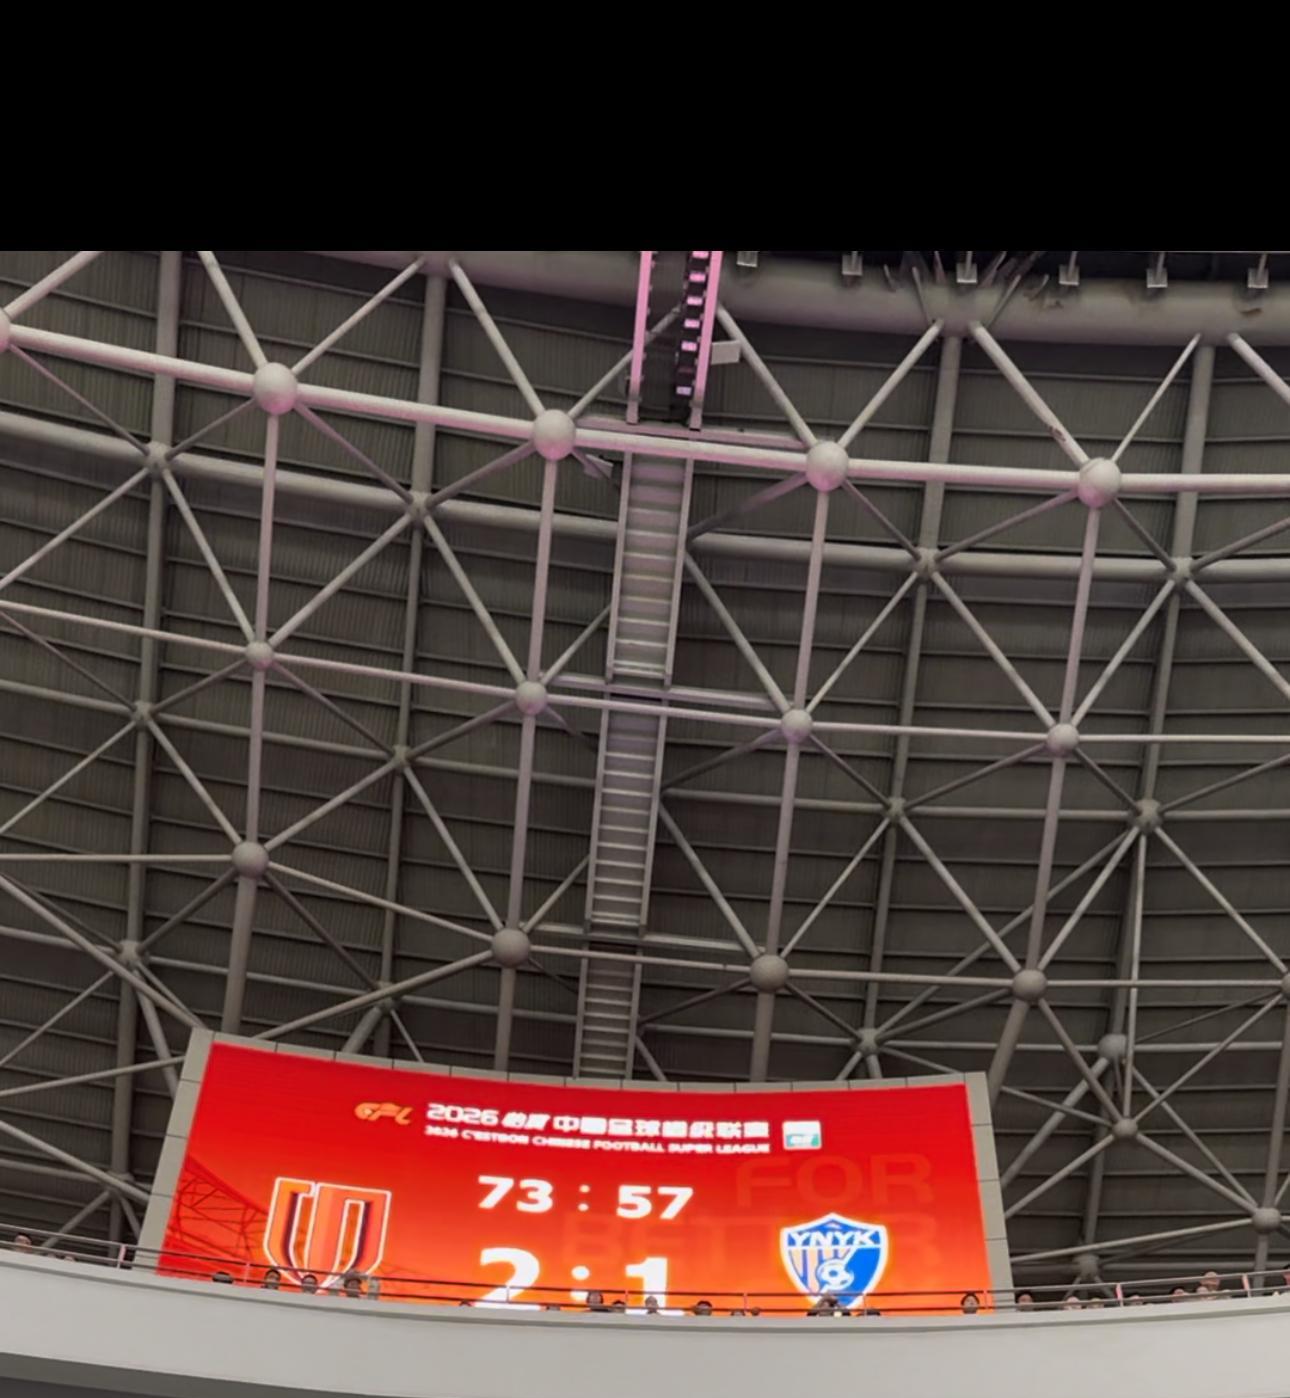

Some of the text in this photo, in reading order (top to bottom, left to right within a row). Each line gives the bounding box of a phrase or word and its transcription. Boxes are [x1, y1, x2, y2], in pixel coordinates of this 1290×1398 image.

[426, 1103, 499, 1126] 2026
[593, 1139, 665, 1153] FOOTBALL
[668, 1142, 713, 1153] SUPER
[716, 1143, 770, 1154] LEAGUE
[737, 1152, 934, 1209] FOR
[788, 1230, 877, 1248] YNYK
